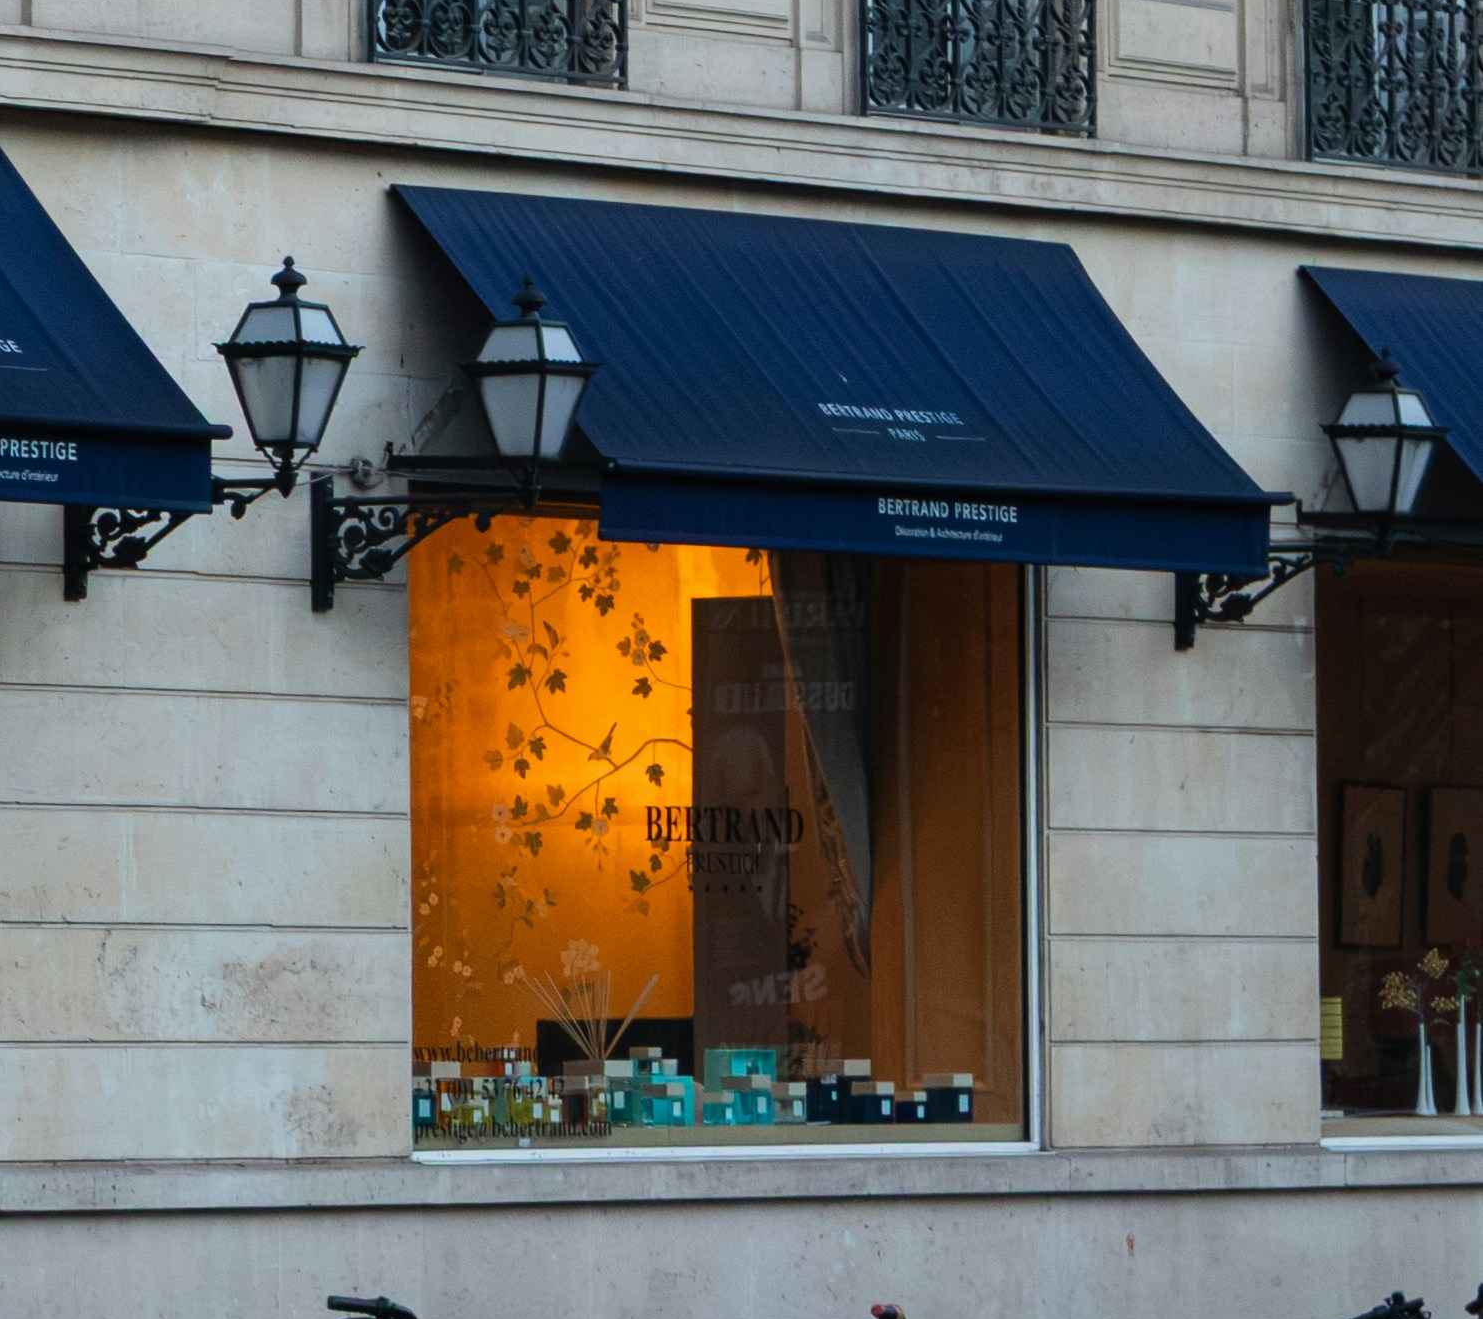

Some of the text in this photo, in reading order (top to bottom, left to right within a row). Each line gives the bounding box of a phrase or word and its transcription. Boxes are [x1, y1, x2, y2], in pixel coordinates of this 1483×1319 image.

[818, 402, 965, 426] BERTRAND PRESTIGE
[887, 427, 926, 442] PARIS
[0, 437, 78, 462] PRESTIGE
[877, 497, 1018, 524] BERTRAND PRESTIGE
[645, 805, 804, 845] BERTRAND
[686, 850, 766, 875] PRESTIGE
